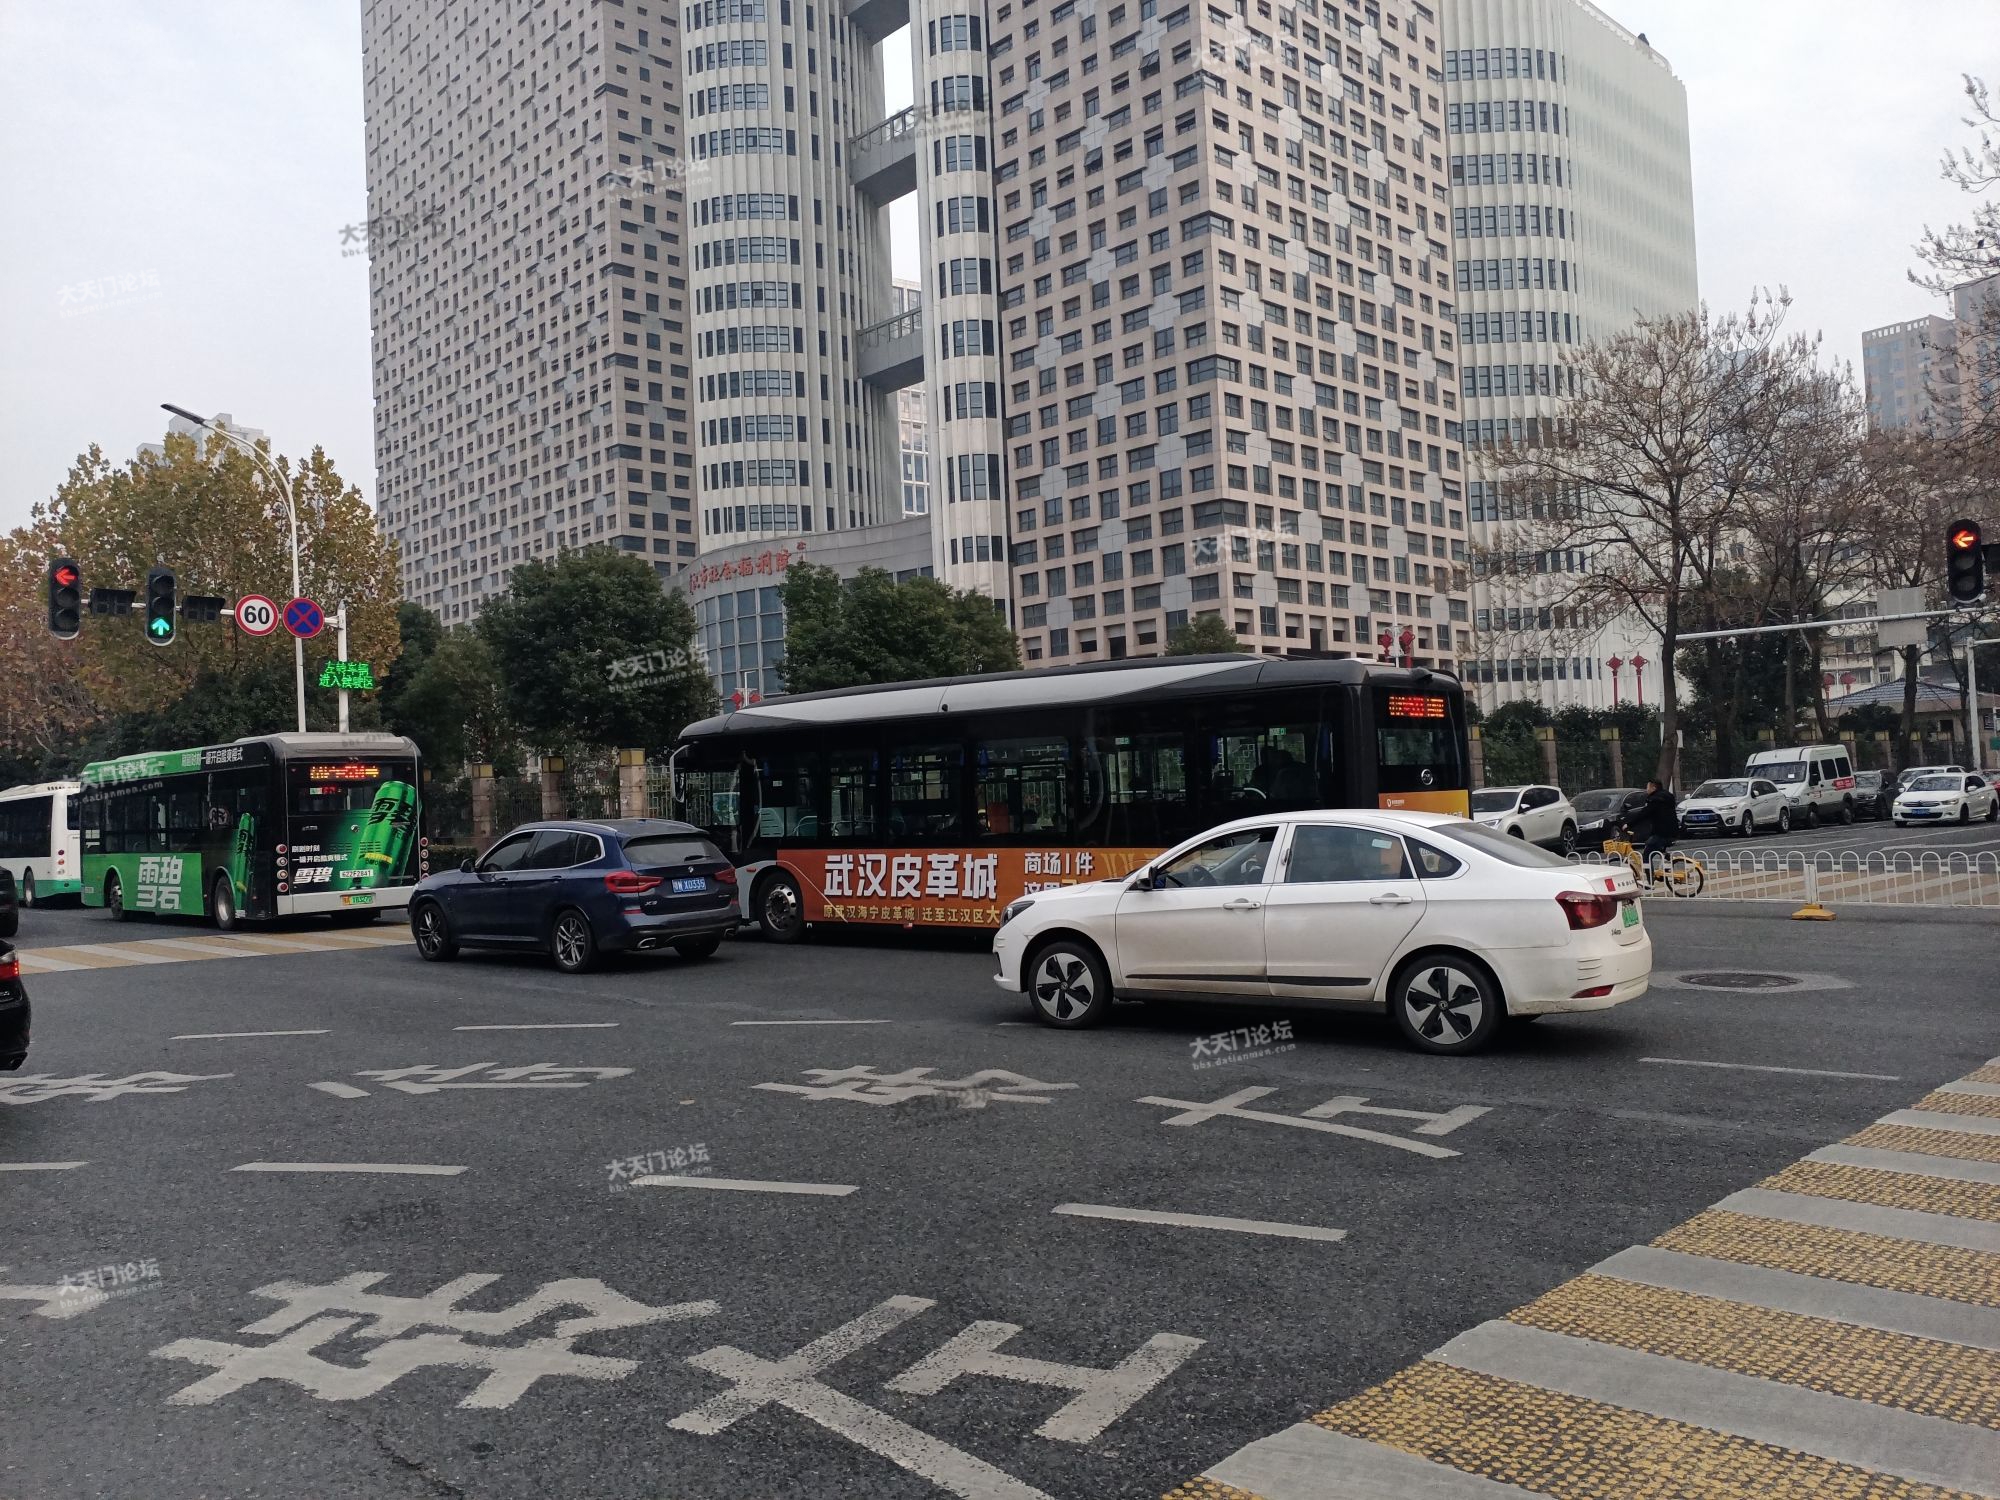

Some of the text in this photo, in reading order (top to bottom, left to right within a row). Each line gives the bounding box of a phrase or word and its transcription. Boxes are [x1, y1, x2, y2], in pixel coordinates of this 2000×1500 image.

[244, 605, 270, 625] 60
[136, 855, 184, 910] 雪碧
[293, 866, 333, 884] 雪碧
[823, 853, 998, 900] 武汉皮革城
